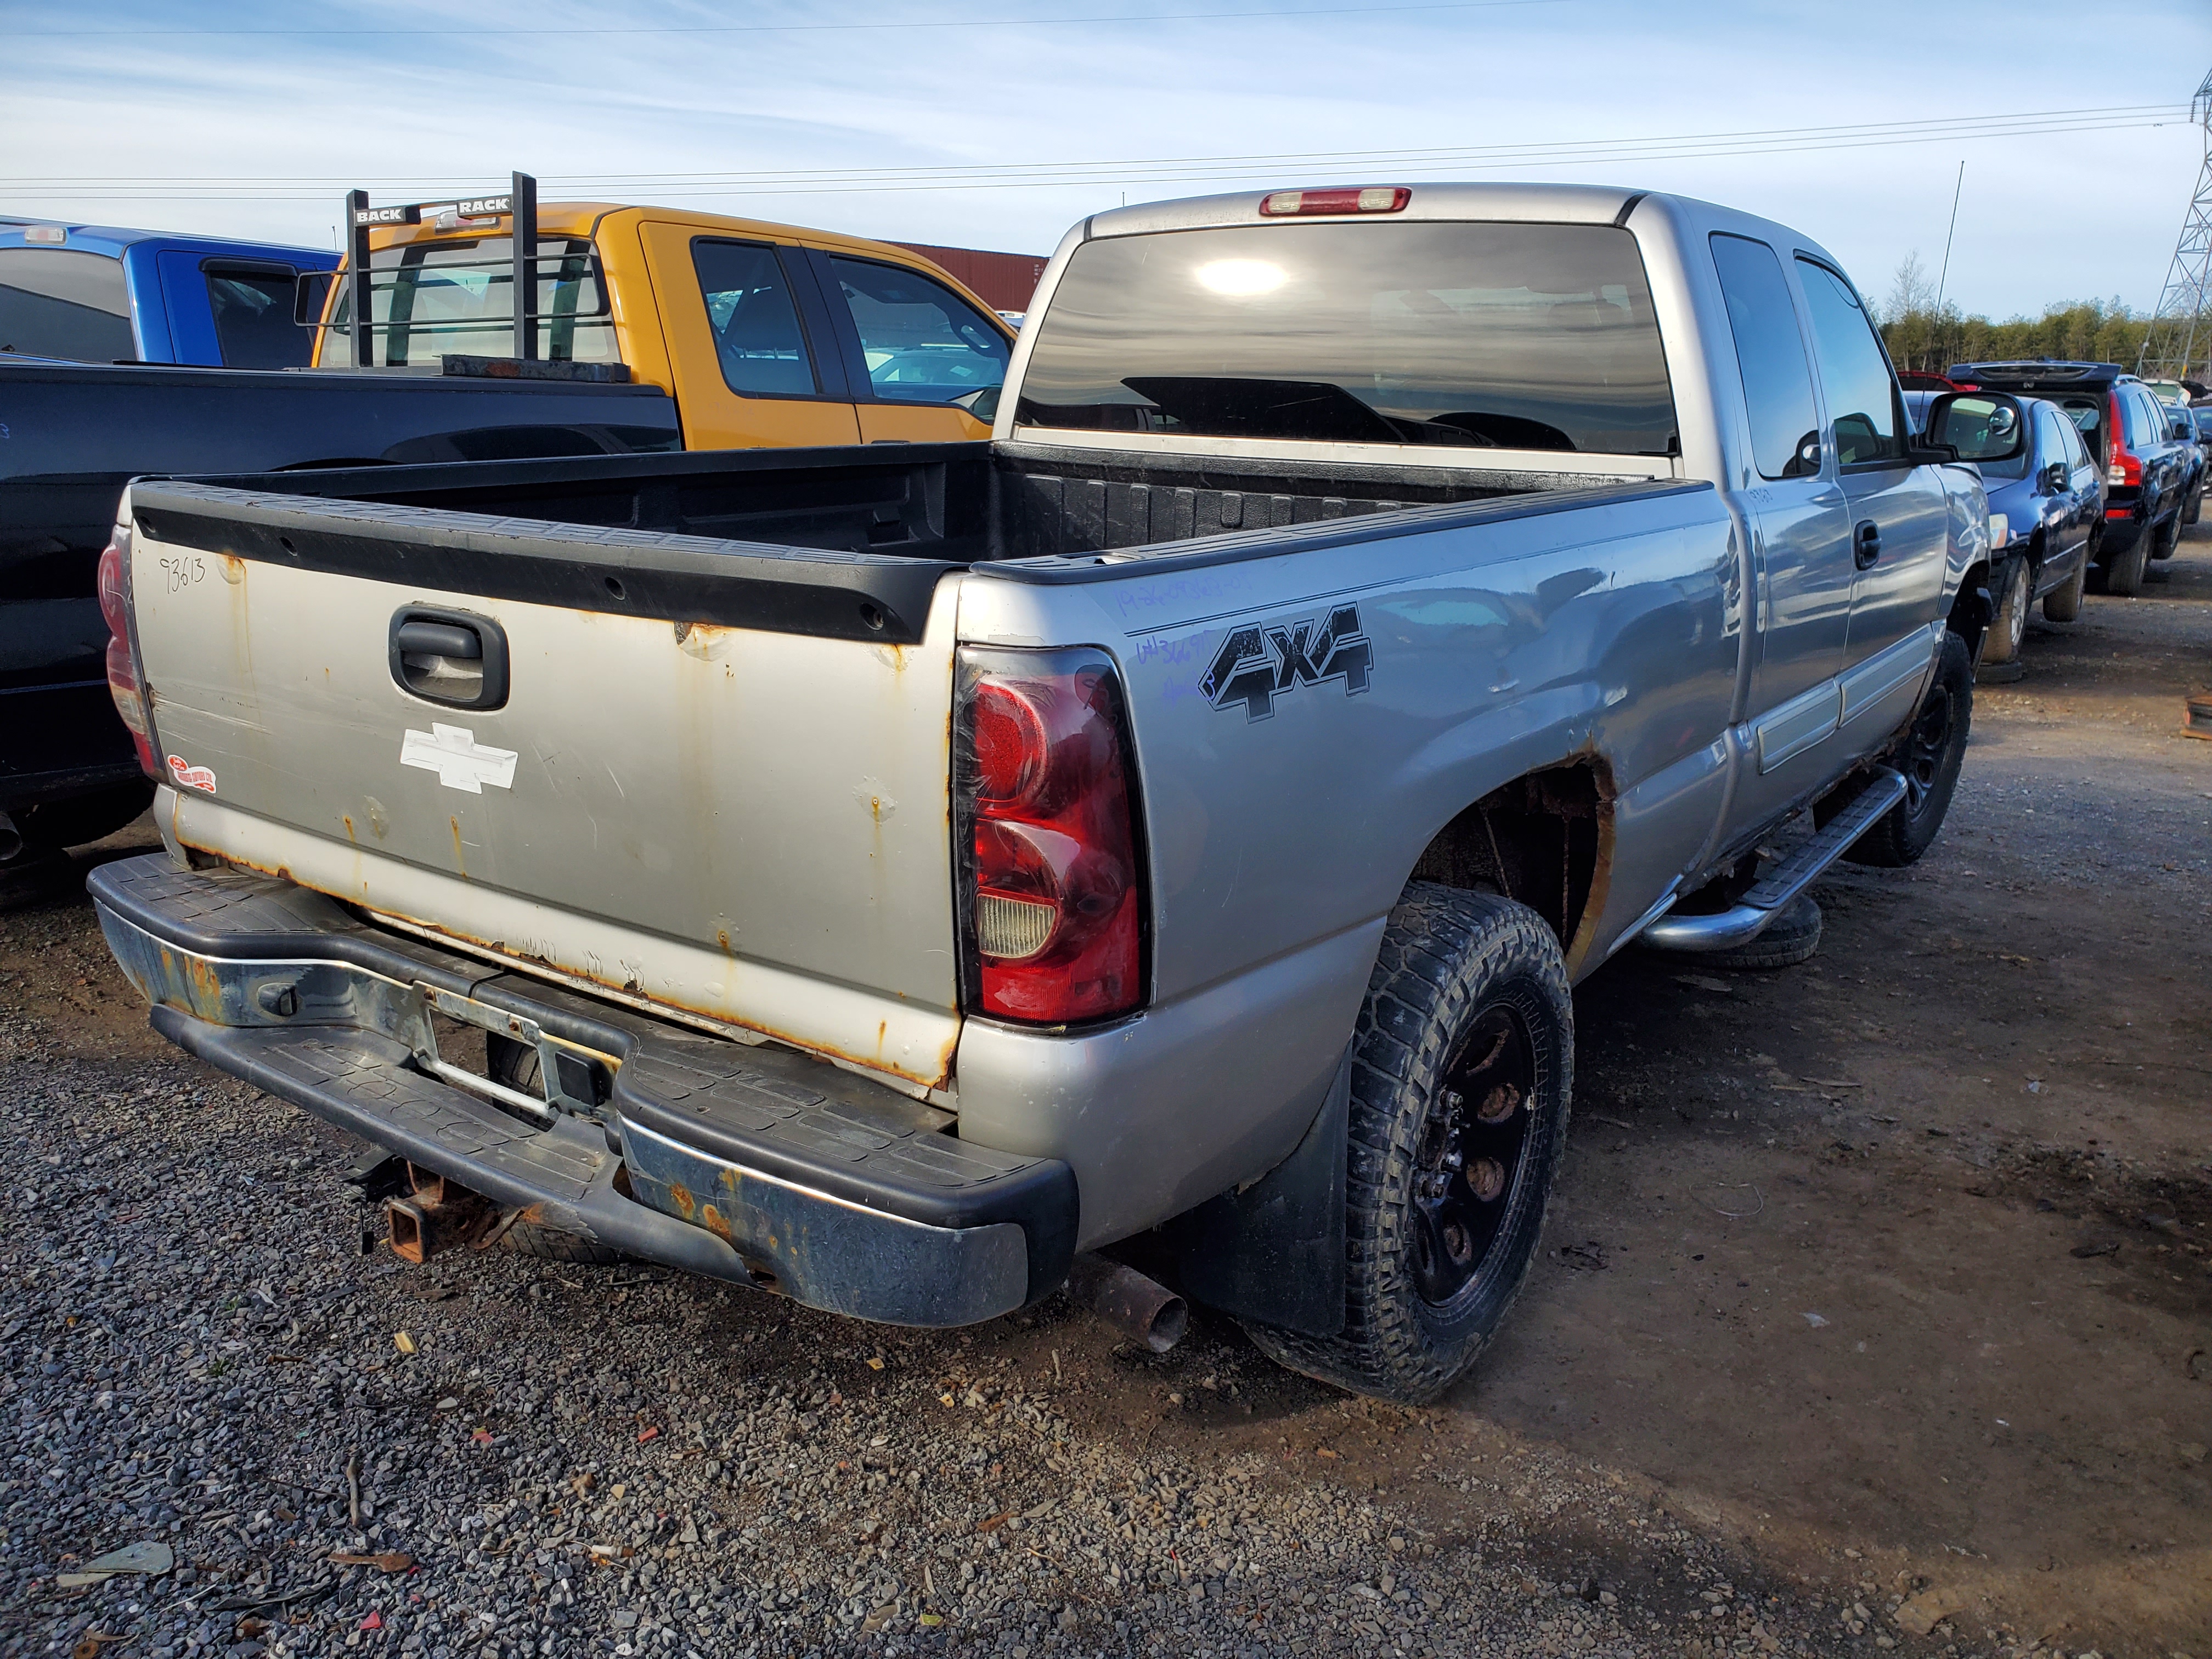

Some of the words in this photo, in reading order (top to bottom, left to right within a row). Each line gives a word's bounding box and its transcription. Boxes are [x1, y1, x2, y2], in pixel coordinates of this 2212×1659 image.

[357, 209, 402, 223] BACK
[459, 198, 509, 213] RACK
[160, 556, 205, 595] 93613
